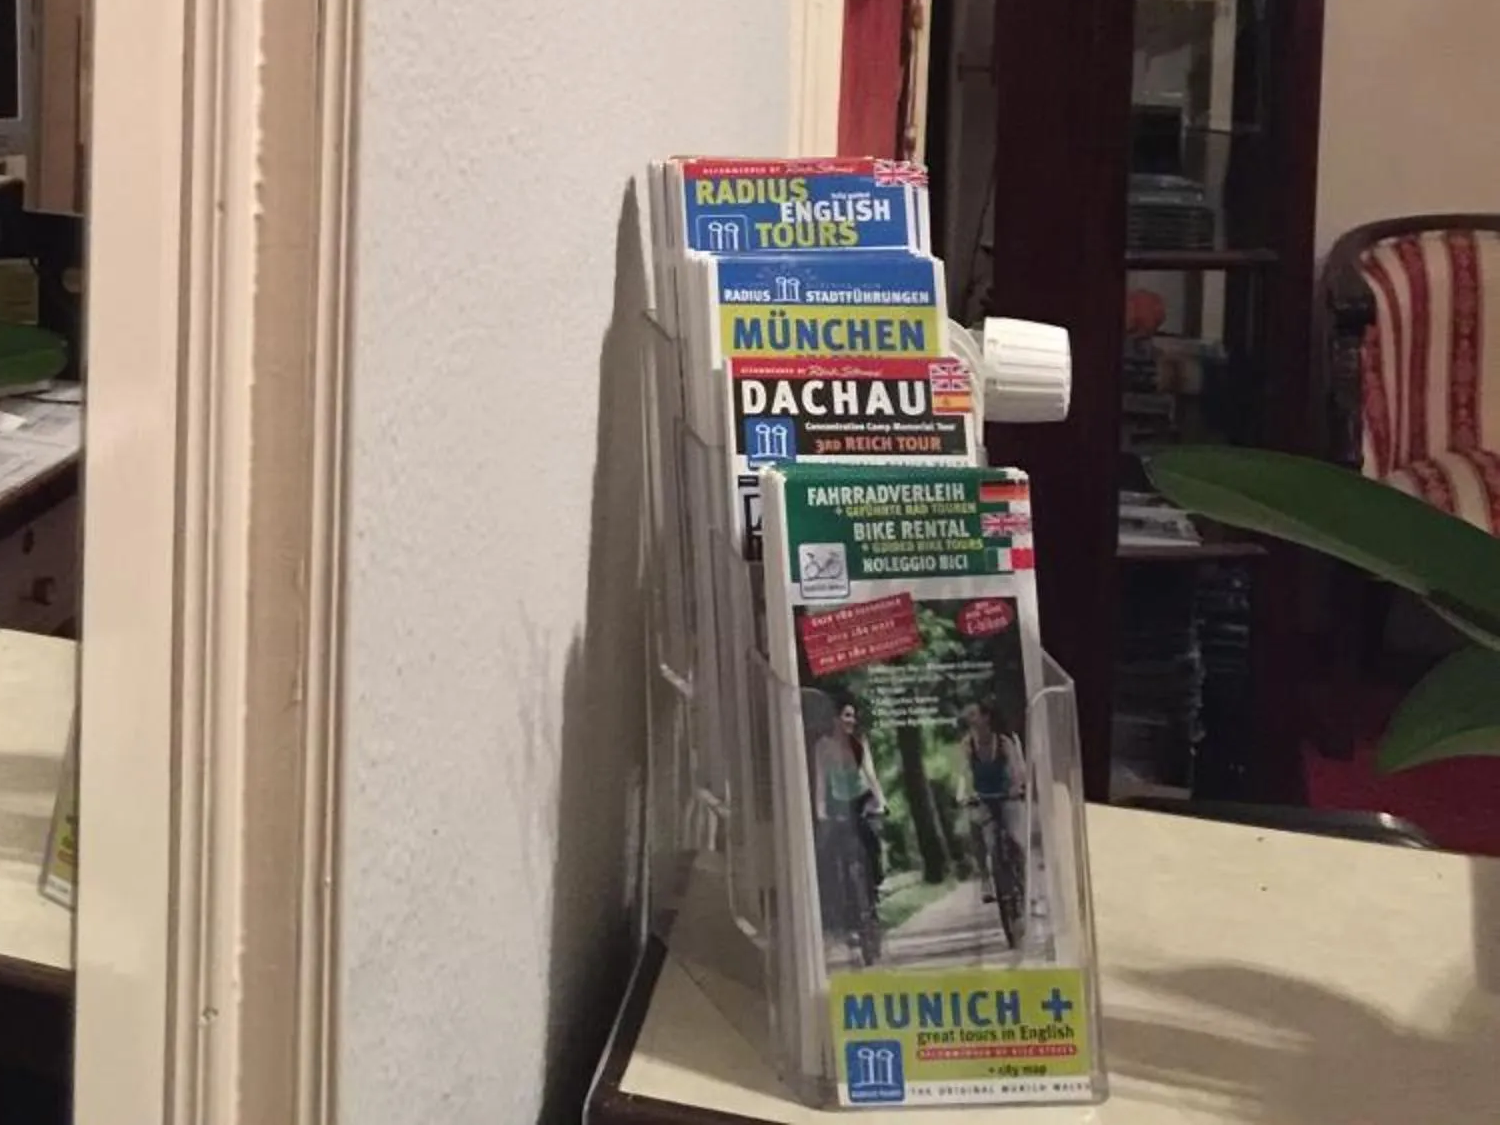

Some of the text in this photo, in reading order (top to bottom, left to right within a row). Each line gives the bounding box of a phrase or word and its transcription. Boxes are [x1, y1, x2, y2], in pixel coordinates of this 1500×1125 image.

[695, 178, 808, 205] RADIUS
[780, 199, 891, 223] ENGLISH
[755, 221, 859, 247] TOURS
[724, 289, 771, 303] RADIUS
[733, 310, 925, 351] MÜNCHEN
[741, 380, 927, 416] DACHAU
[844, 436, 892, 451] REICH
[896, 436, 942, 451] TOUR
[807, 483, 965, 506] FAHRRADVERLEIH
[853, 519, 971, 541] BIKE RENTAL
[862, 554, 968, 572] NOLEGGIO BICI
[843, 990, 1021, 1030] MUNICH
[917, 1024, 1075, 1046] great tours in English
